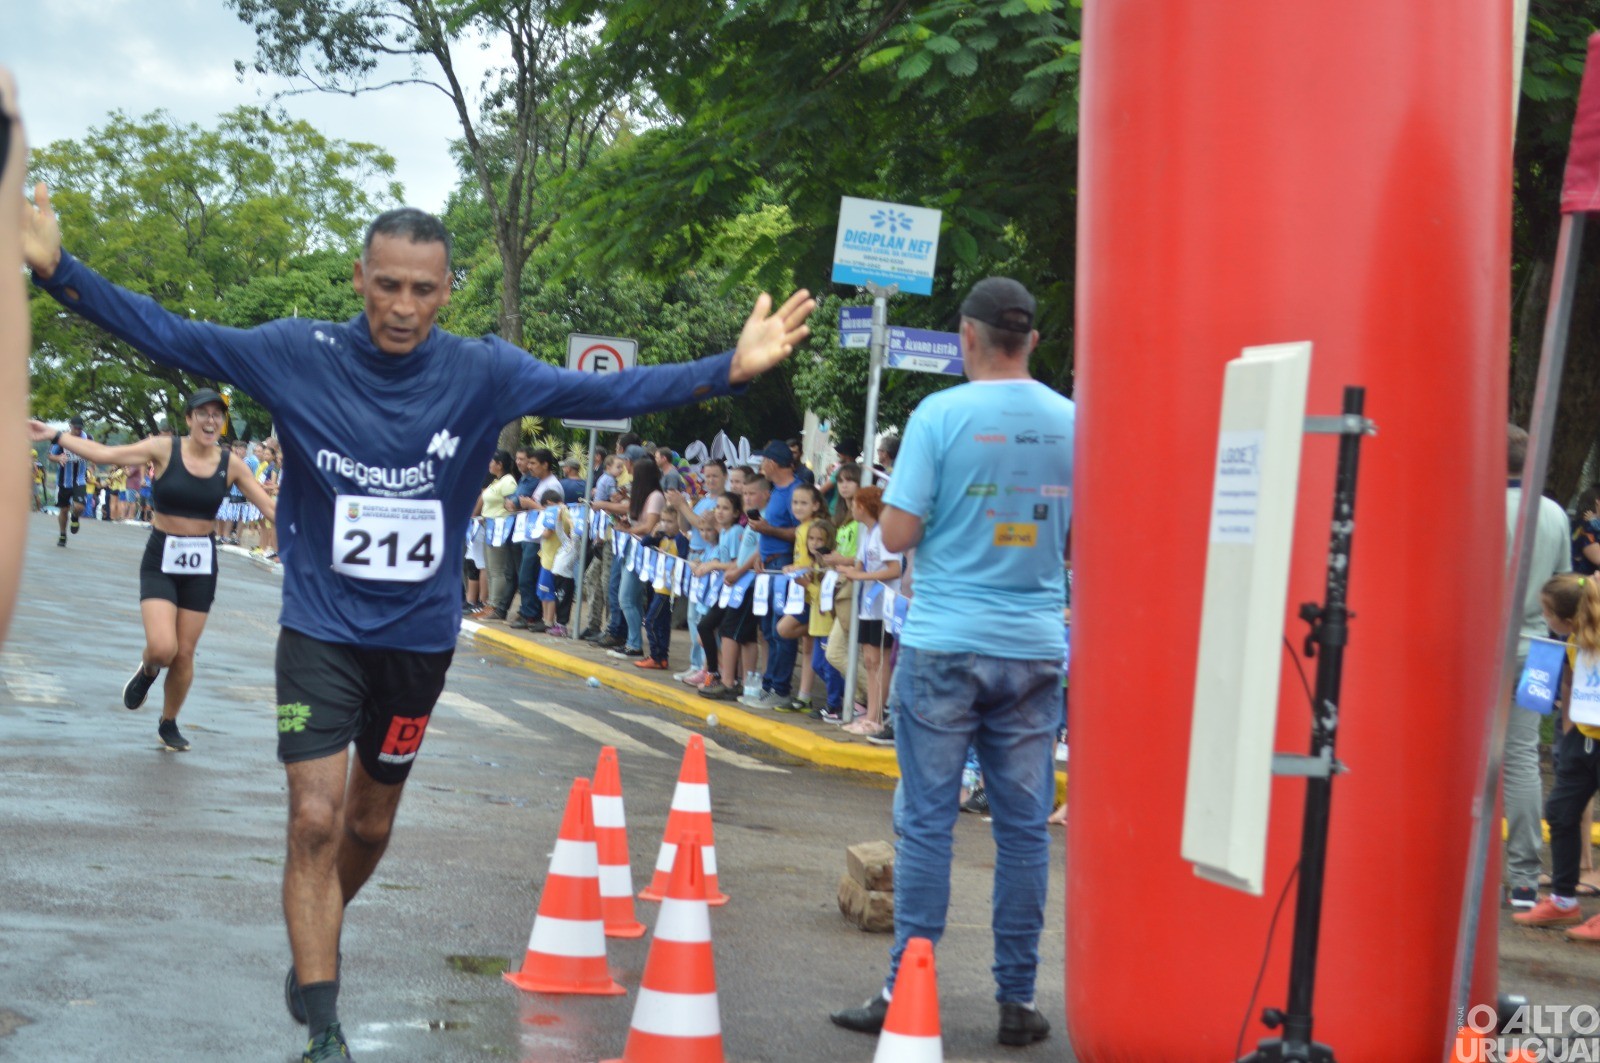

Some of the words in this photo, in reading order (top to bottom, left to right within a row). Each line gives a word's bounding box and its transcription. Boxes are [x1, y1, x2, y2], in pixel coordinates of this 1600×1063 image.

[844, 229, 906, 251] DIGIPLAN
[908, 238, 933, 254] NET
[890, 338, 903, 350] DR.
[933, 343, 958, 356] LEITÃO
[317, 449, 435, 489] megawatt
[174, 553, 202, 569] 40
[342, 529, 434, 568] 214
